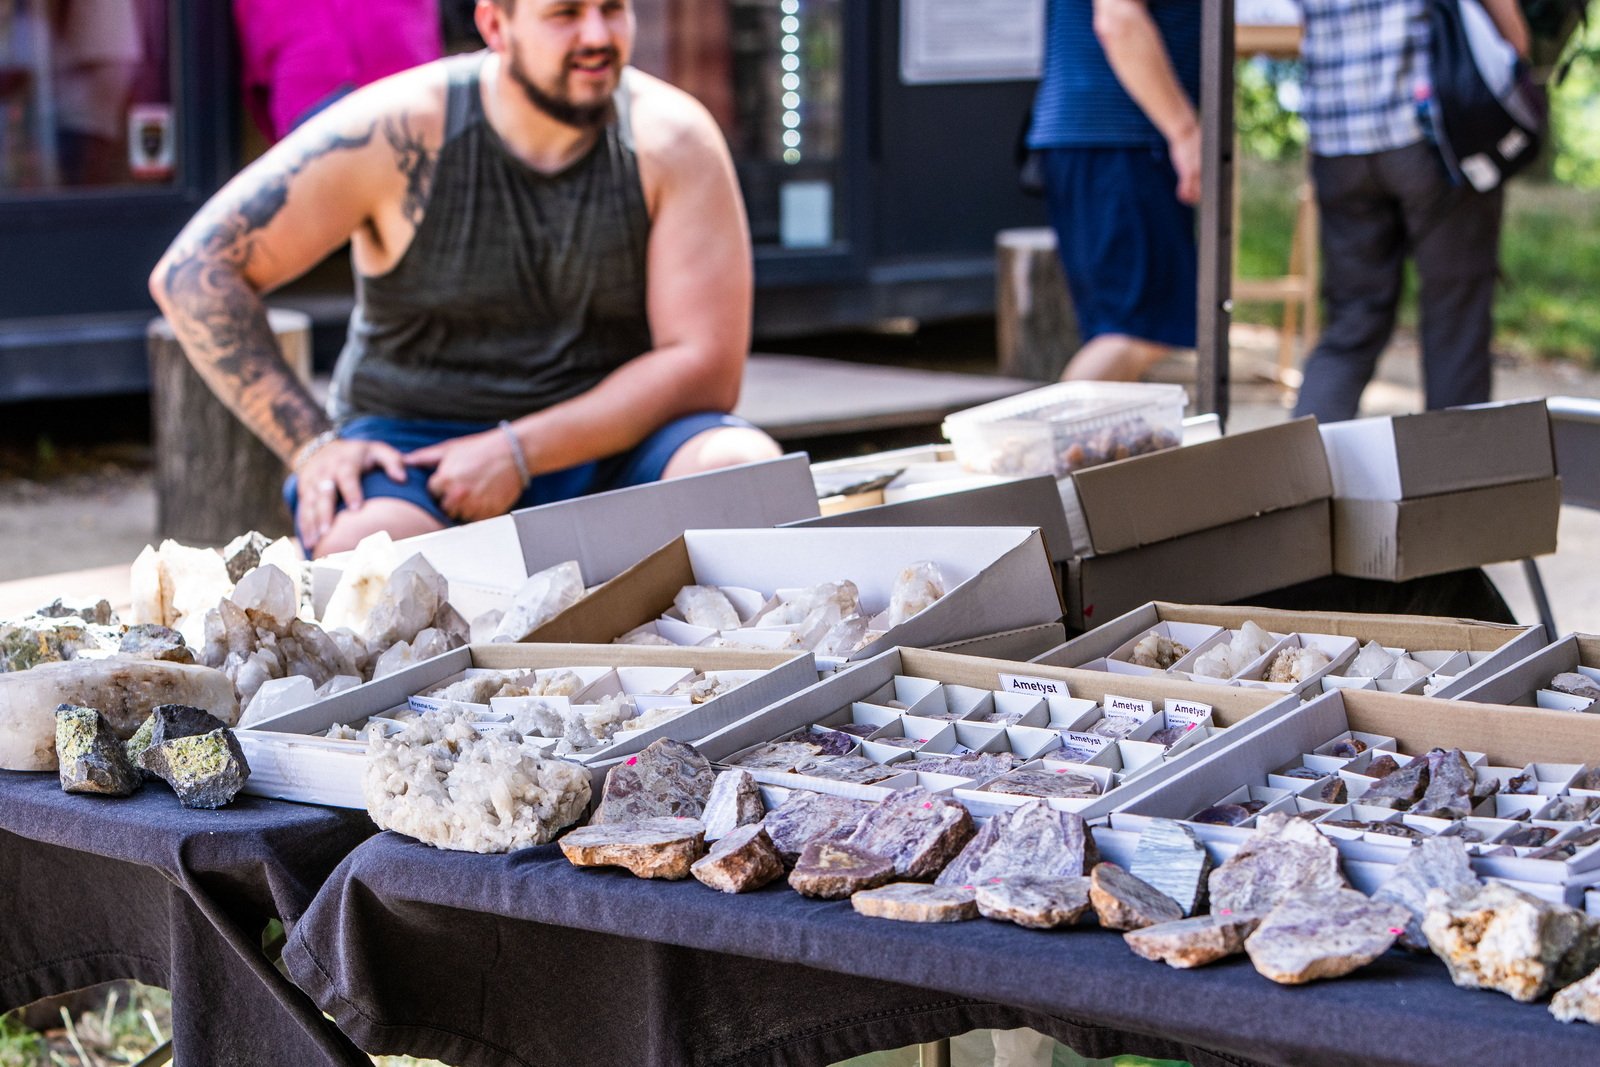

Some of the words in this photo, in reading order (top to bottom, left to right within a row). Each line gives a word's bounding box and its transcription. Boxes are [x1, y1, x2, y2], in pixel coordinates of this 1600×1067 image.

[1013, 678, 1058, 694] Ametyst
[1112, 699, 1145, 713] Ametyst
[1174, 703, 1206, 717] Ametyst
[1070, 734, 1102, 746] Ametyst
